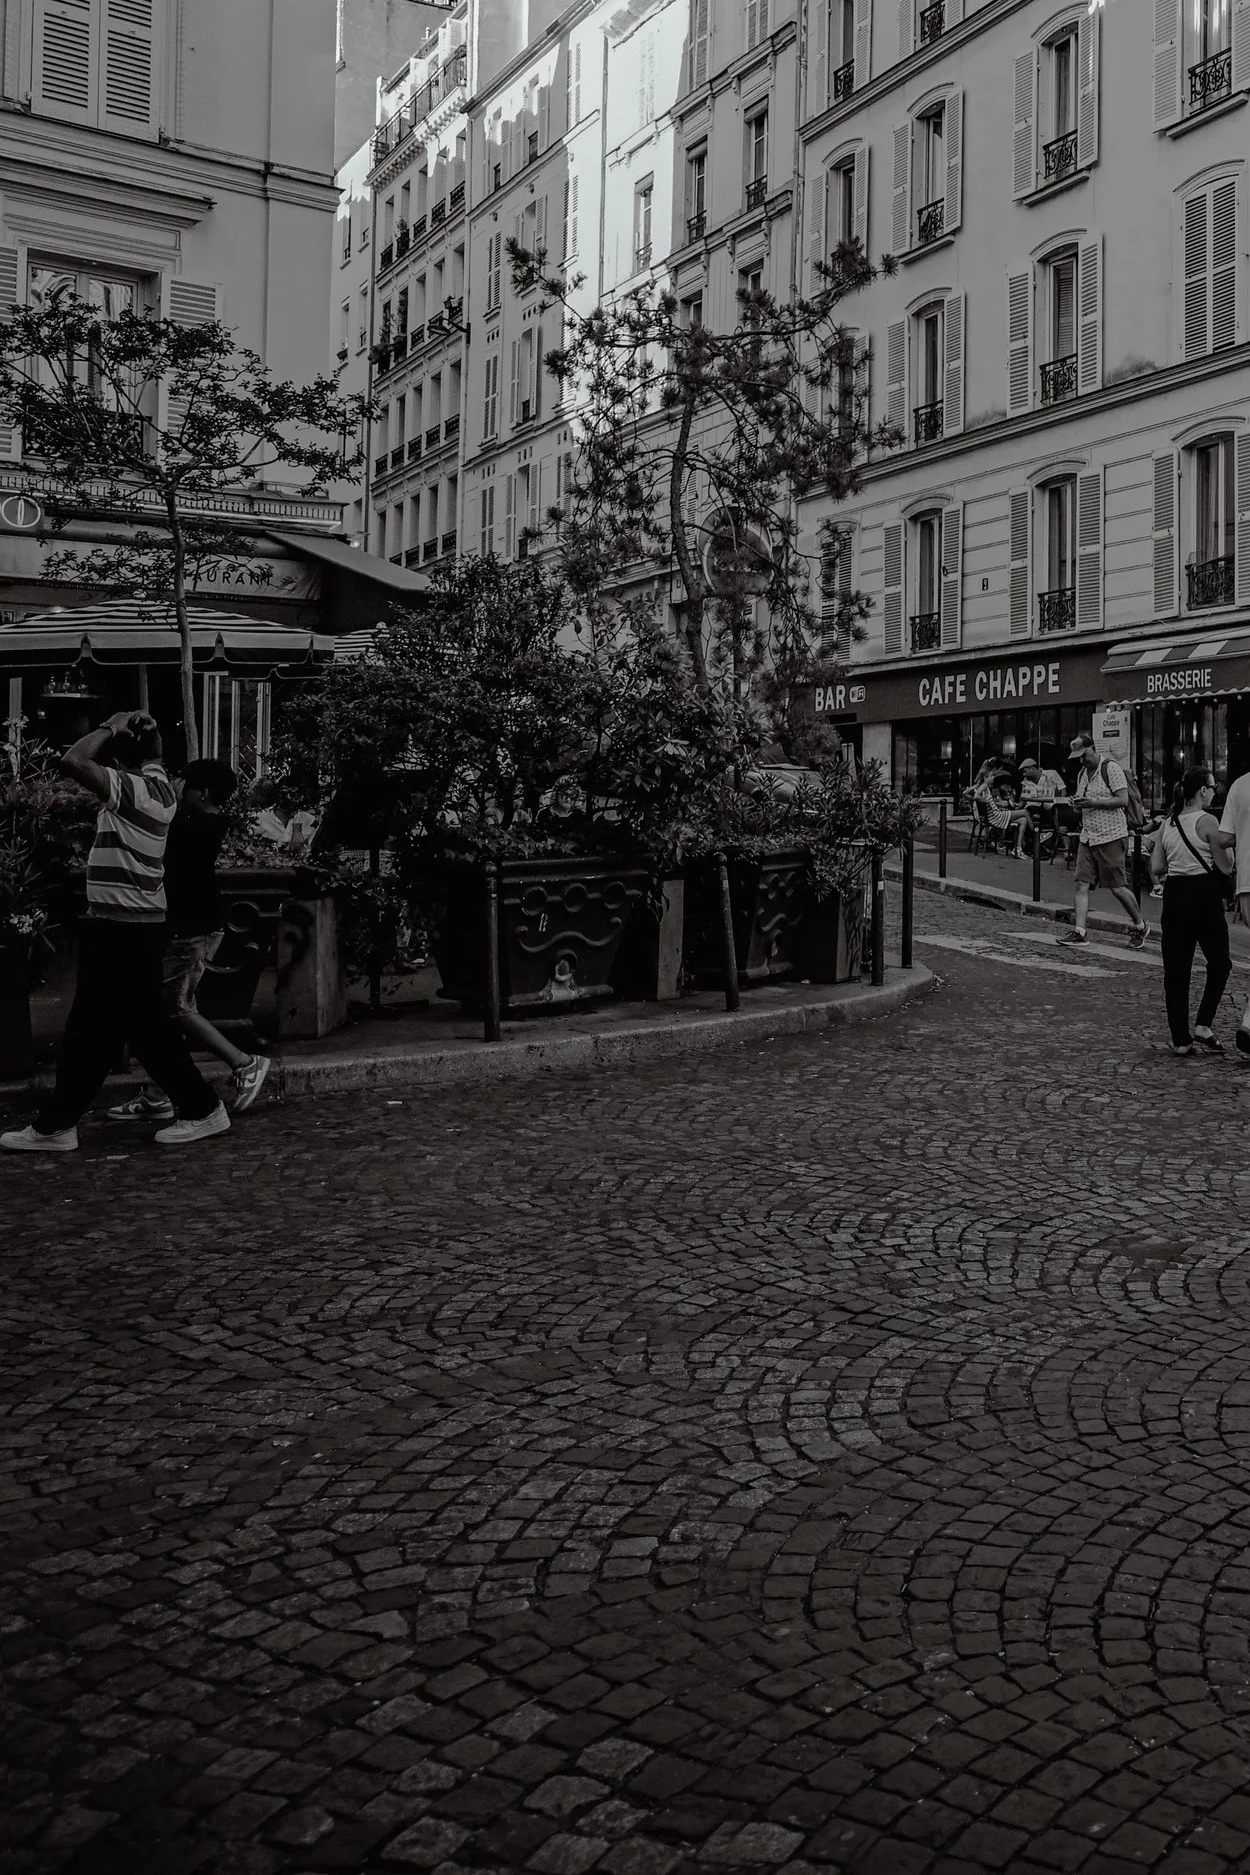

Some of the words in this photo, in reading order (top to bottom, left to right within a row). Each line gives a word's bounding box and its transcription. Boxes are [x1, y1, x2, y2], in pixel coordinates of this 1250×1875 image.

[918, 673, 967, 707] CAFE
[975, 662, 1060, 701] CHAPPE
[1147, 668, 1212, 694] BRASSERIE
[815, 684, 846, 712] BAR
